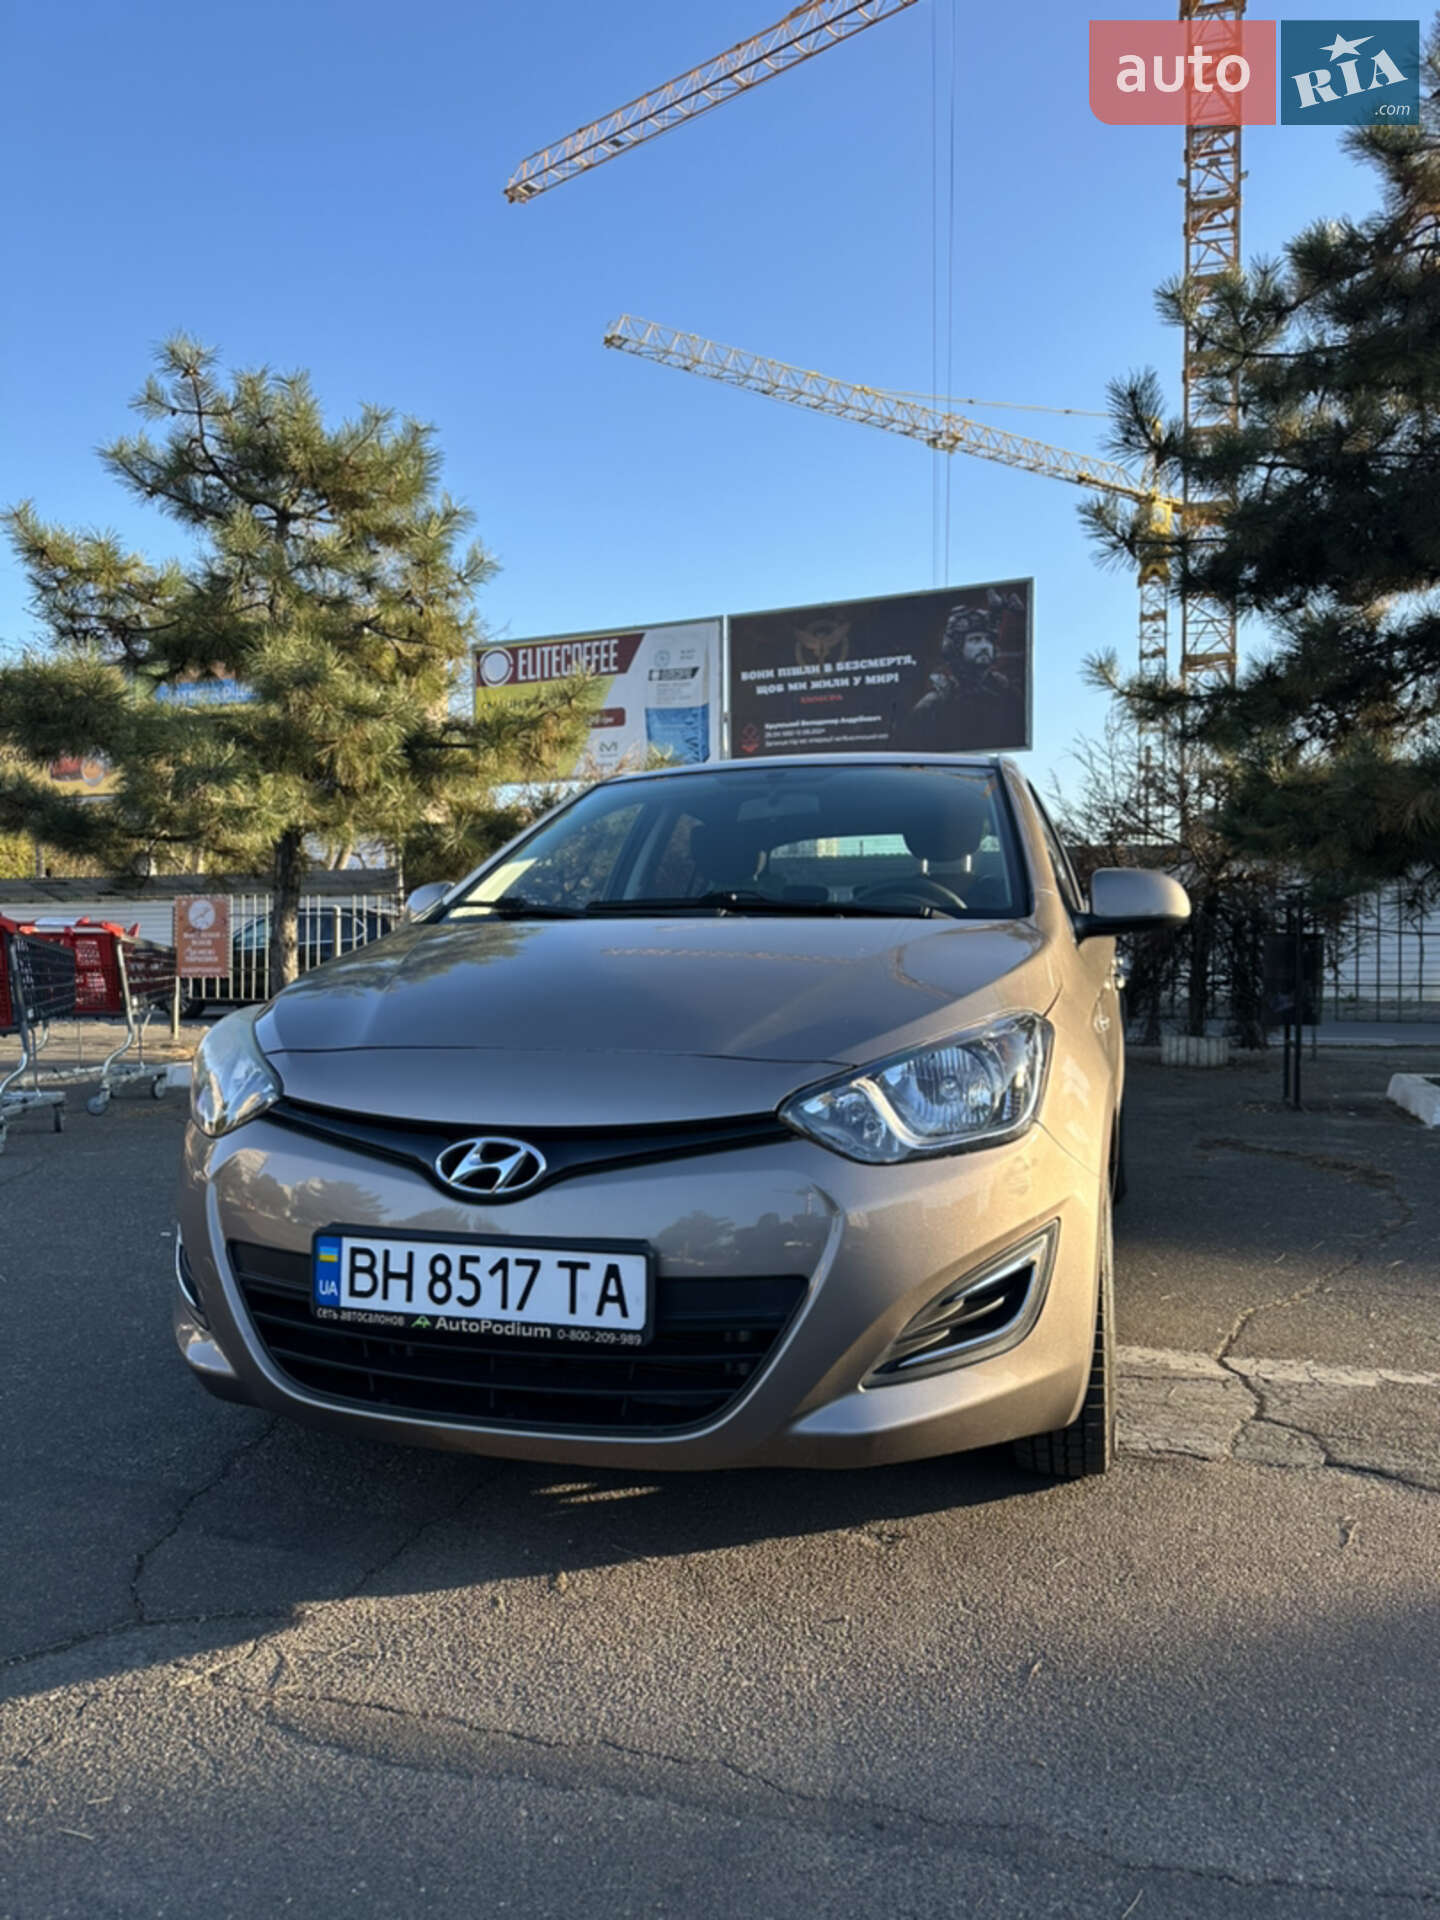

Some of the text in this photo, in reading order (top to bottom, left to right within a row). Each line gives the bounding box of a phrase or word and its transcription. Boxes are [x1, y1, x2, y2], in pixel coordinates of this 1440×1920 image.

[517, 639, 619, 681] ELITECOFFEE
[741, 669, 774, 681] ВОНИ
[823, 662, 833, 673] В
[756, 683, 784, 695] ЩОБ
[788, 681, 807, 692] МИ
[853, 676, 862, 686] У
[318, 1279, 339, 1296] UA
[348, 1246, 630, 1319] BH 8517 TA
[339, 1309, 405, 1327] автосалонов
[435, 1317, 643, 1347] AutoPodium 0-800-209-989
